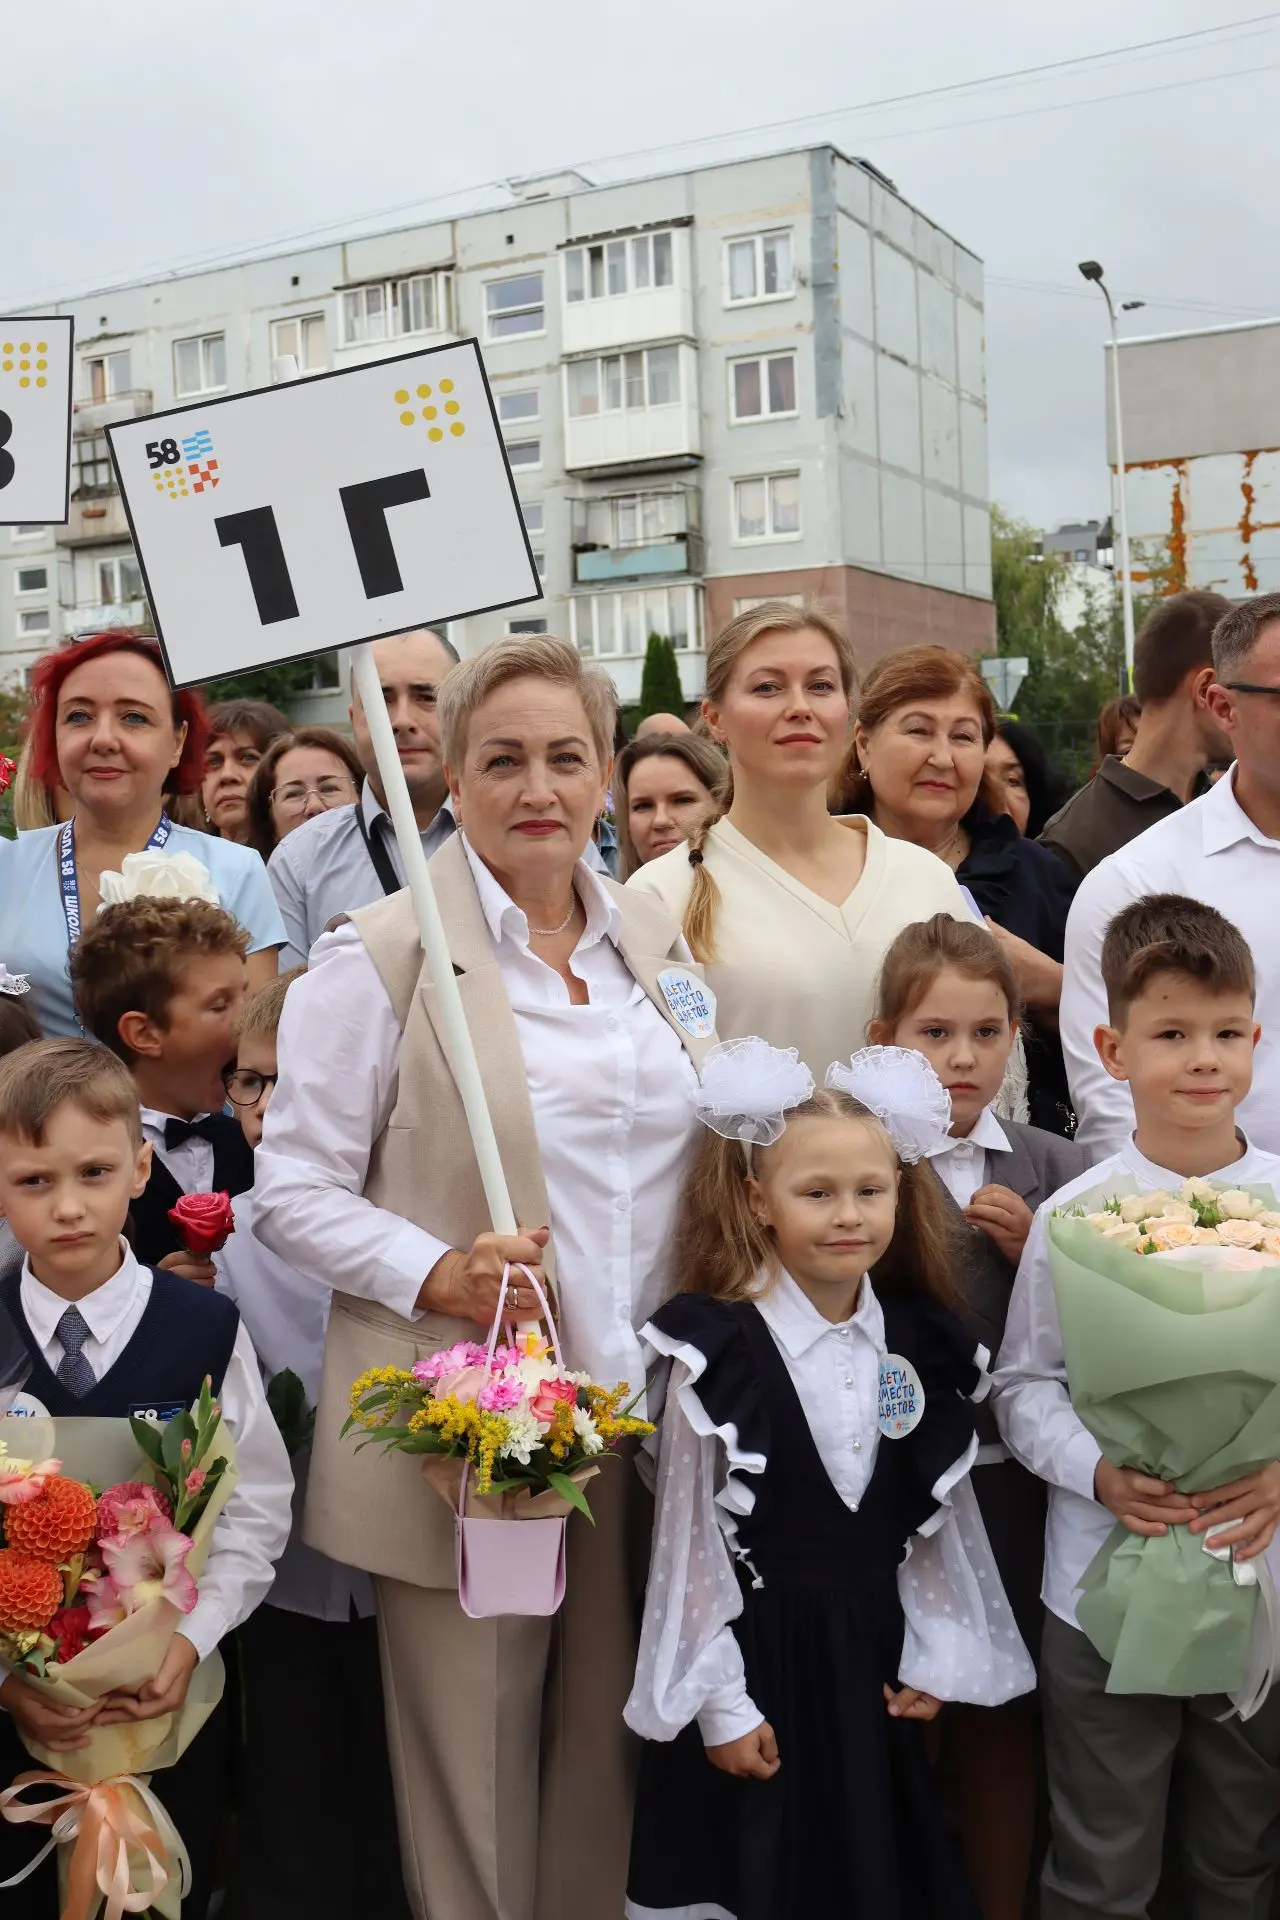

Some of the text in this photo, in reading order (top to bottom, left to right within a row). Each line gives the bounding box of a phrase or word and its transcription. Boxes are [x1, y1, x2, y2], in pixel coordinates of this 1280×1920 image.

[145, 438, 181, 470] 58
[214, 505, 300, 625] 1
[153, 827, 168, 845] 58
[61, 860, 75, 876] 58
[665, 979, 692, 997] ДЕТИ
[668, 990, 704, 1010] ВМЕСТО
[676, 1004, 709, 1022] ЦВЕТОВ
[880, 1370, 907, 1385] ДЕТИ
